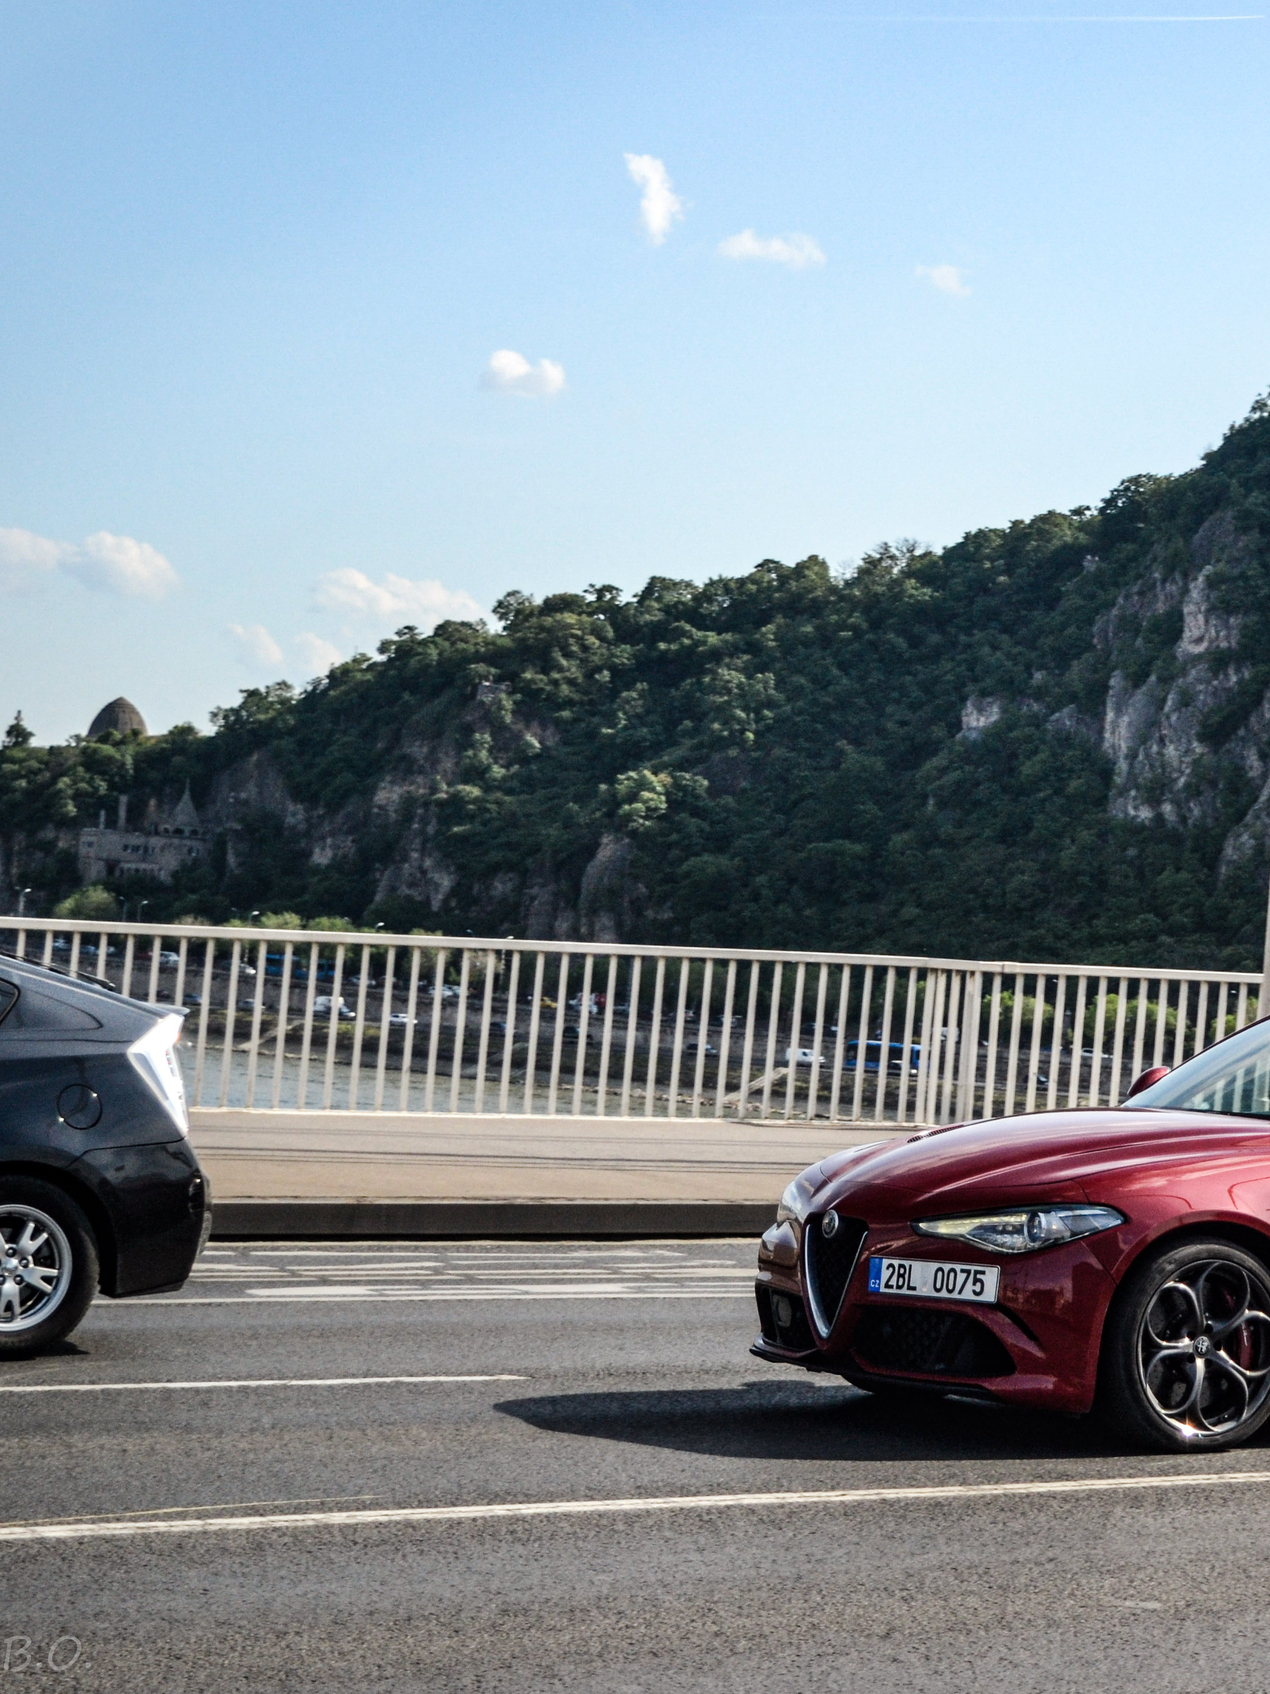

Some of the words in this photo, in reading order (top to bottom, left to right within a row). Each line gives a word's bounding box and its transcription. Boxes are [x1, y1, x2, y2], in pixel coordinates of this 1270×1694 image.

[870, 1279, 879, 1288] CZ
[884, 1263, 917, 1291] 2BL
[933, 1266, 986, 1297] 0075
